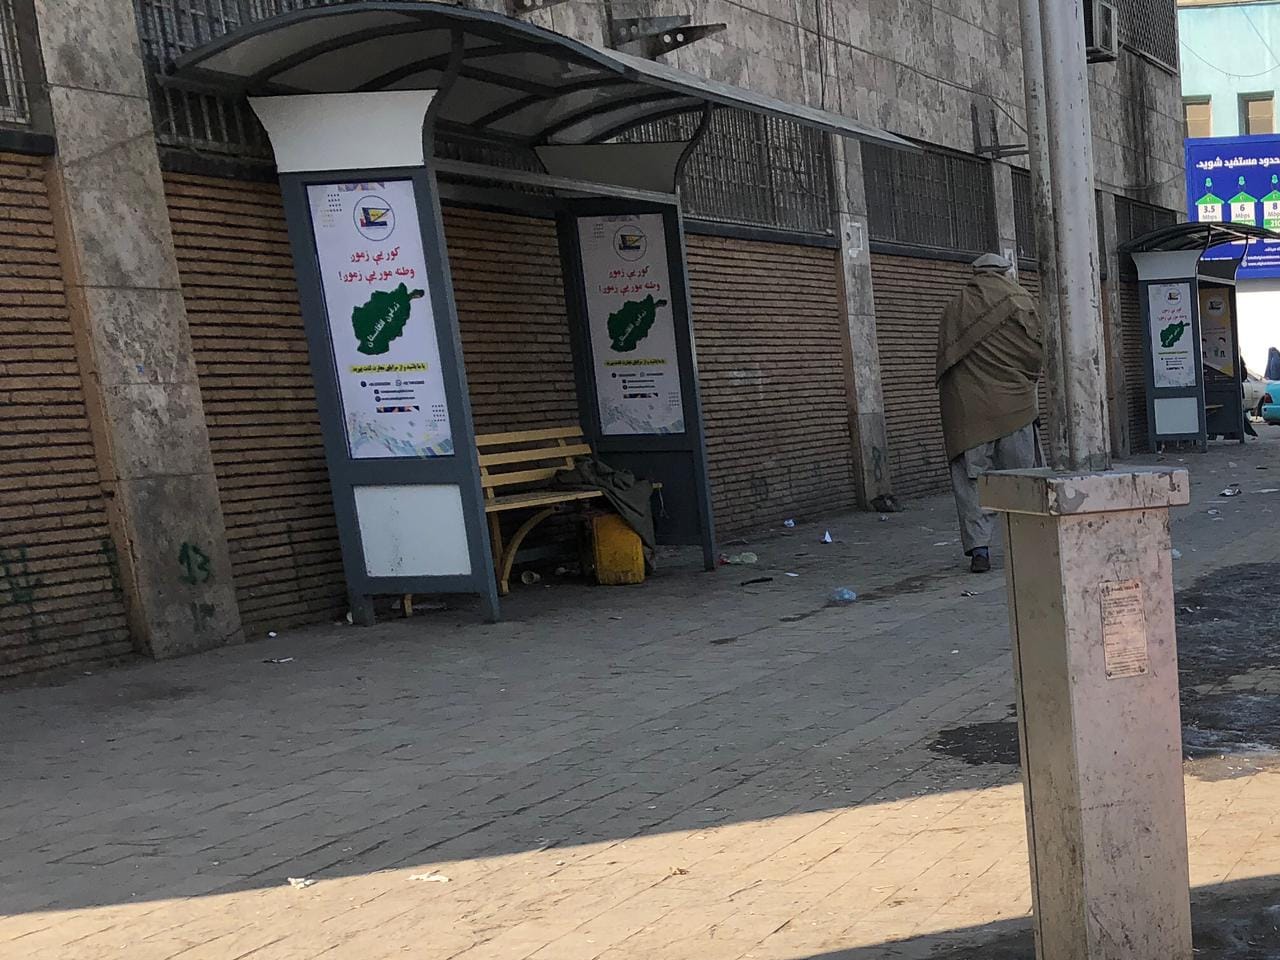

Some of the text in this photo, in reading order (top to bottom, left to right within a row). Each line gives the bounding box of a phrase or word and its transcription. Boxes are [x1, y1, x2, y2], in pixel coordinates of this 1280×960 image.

[1224, 157, 1257, 169] مستفید
[1203, 205, 1216, 214] 3.5
[1239, 204, 1246, 212] 6
[386, 246, 400, 261] کور
[367, 319, 386, 348] افغانستان
